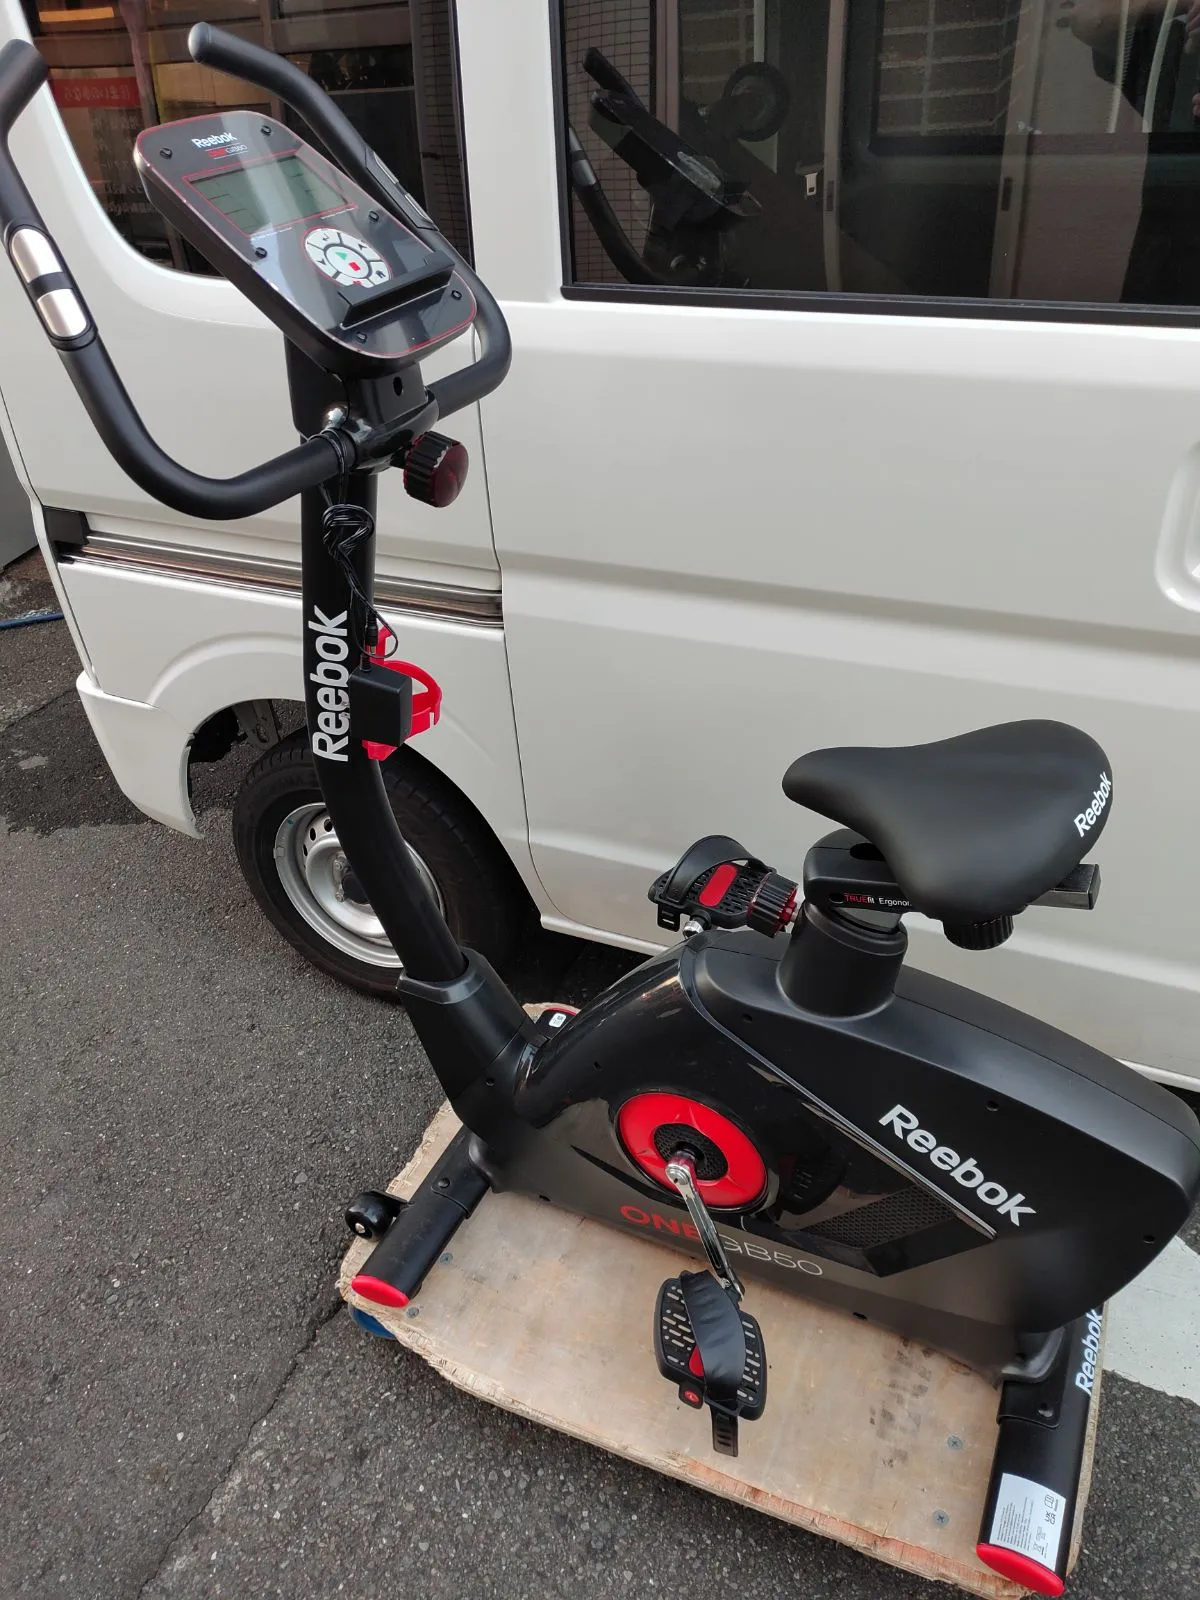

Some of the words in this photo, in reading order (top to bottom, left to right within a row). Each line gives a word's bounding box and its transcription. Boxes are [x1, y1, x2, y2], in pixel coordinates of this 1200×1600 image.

[191, 132, 238, 148] Reebok
[308, 604, 351, 762] Reebok
[1073, 771, 1111, 837] Reebok
[878, 1104, 1037, 1227] Reebok
[1075, 1309, 1103, 1396] Reebok
